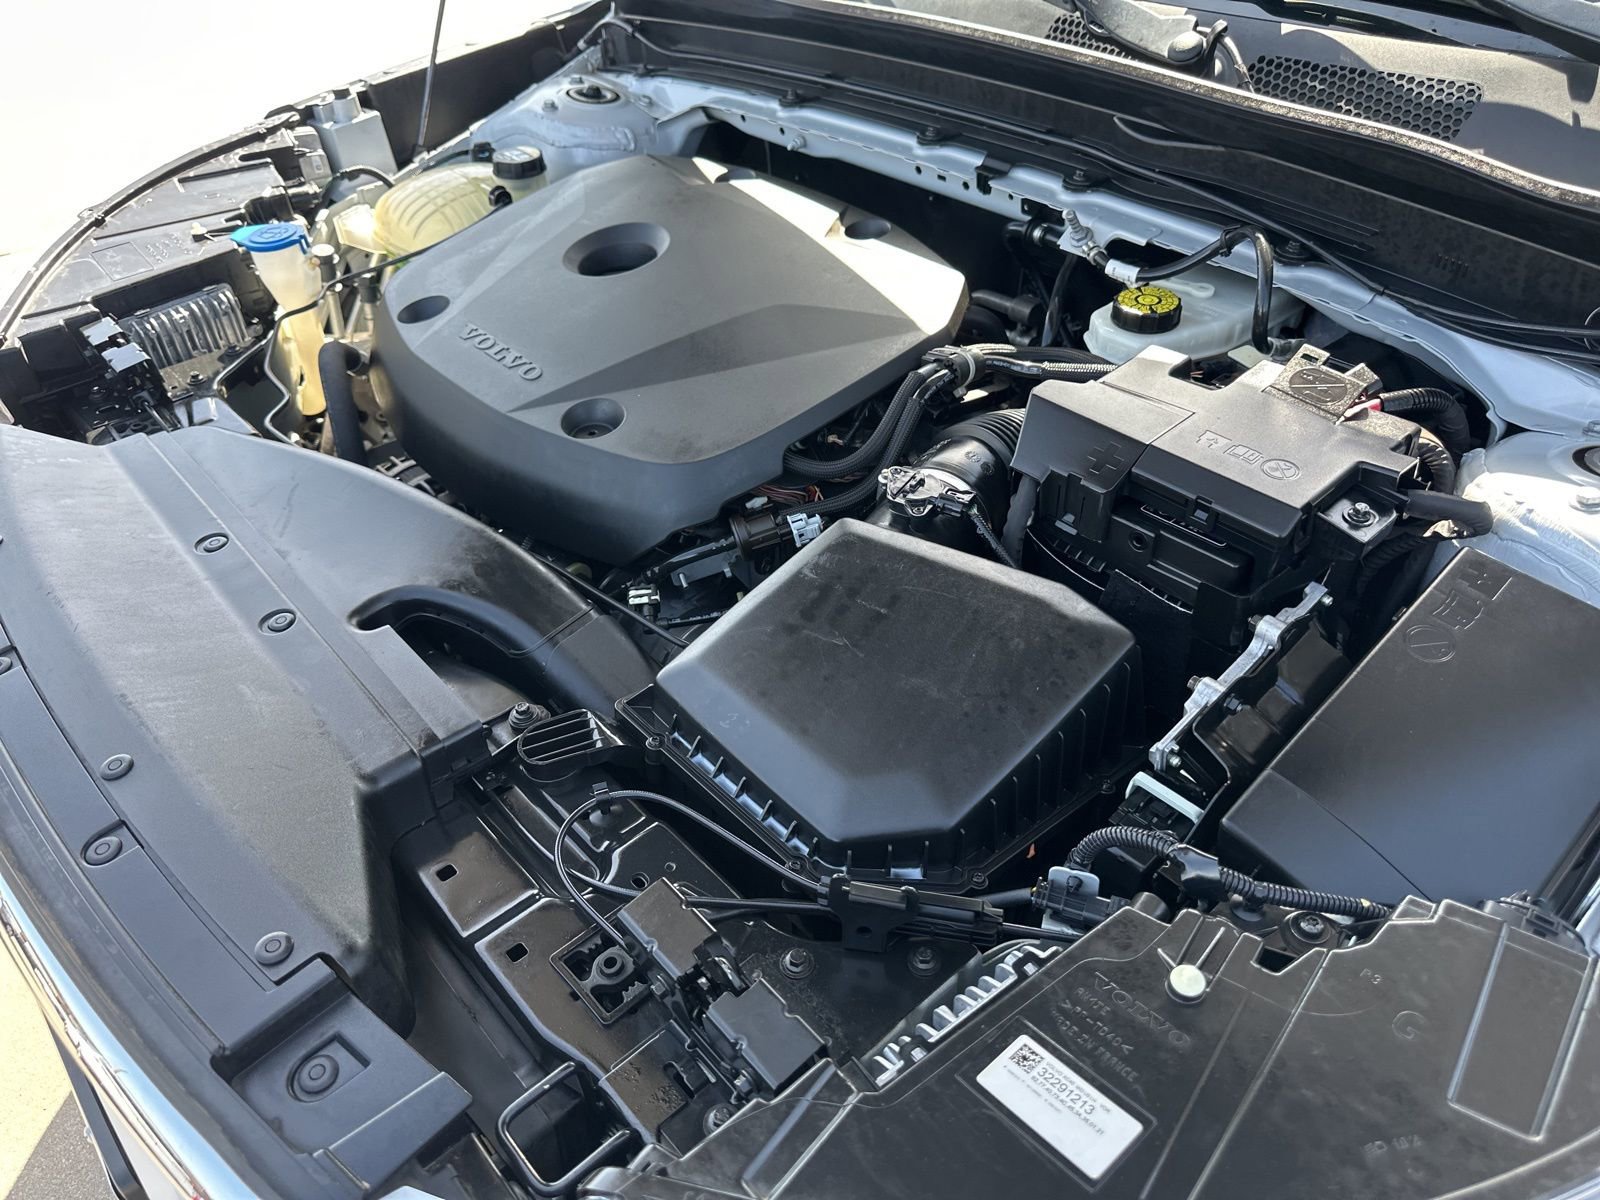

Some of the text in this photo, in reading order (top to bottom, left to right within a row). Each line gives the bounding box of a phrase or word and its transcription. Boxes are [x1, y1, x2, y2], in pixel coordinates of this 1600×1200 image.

[460, 323, 543, 381] VOLVO
[1094, 970, 1191, 1047] VOLVO
[1391, 1010, 1425, 1040] G
[1094, 1045, 1139, 1082] FRANCE
[1036, 1066, 1096, 1115] 32291213
